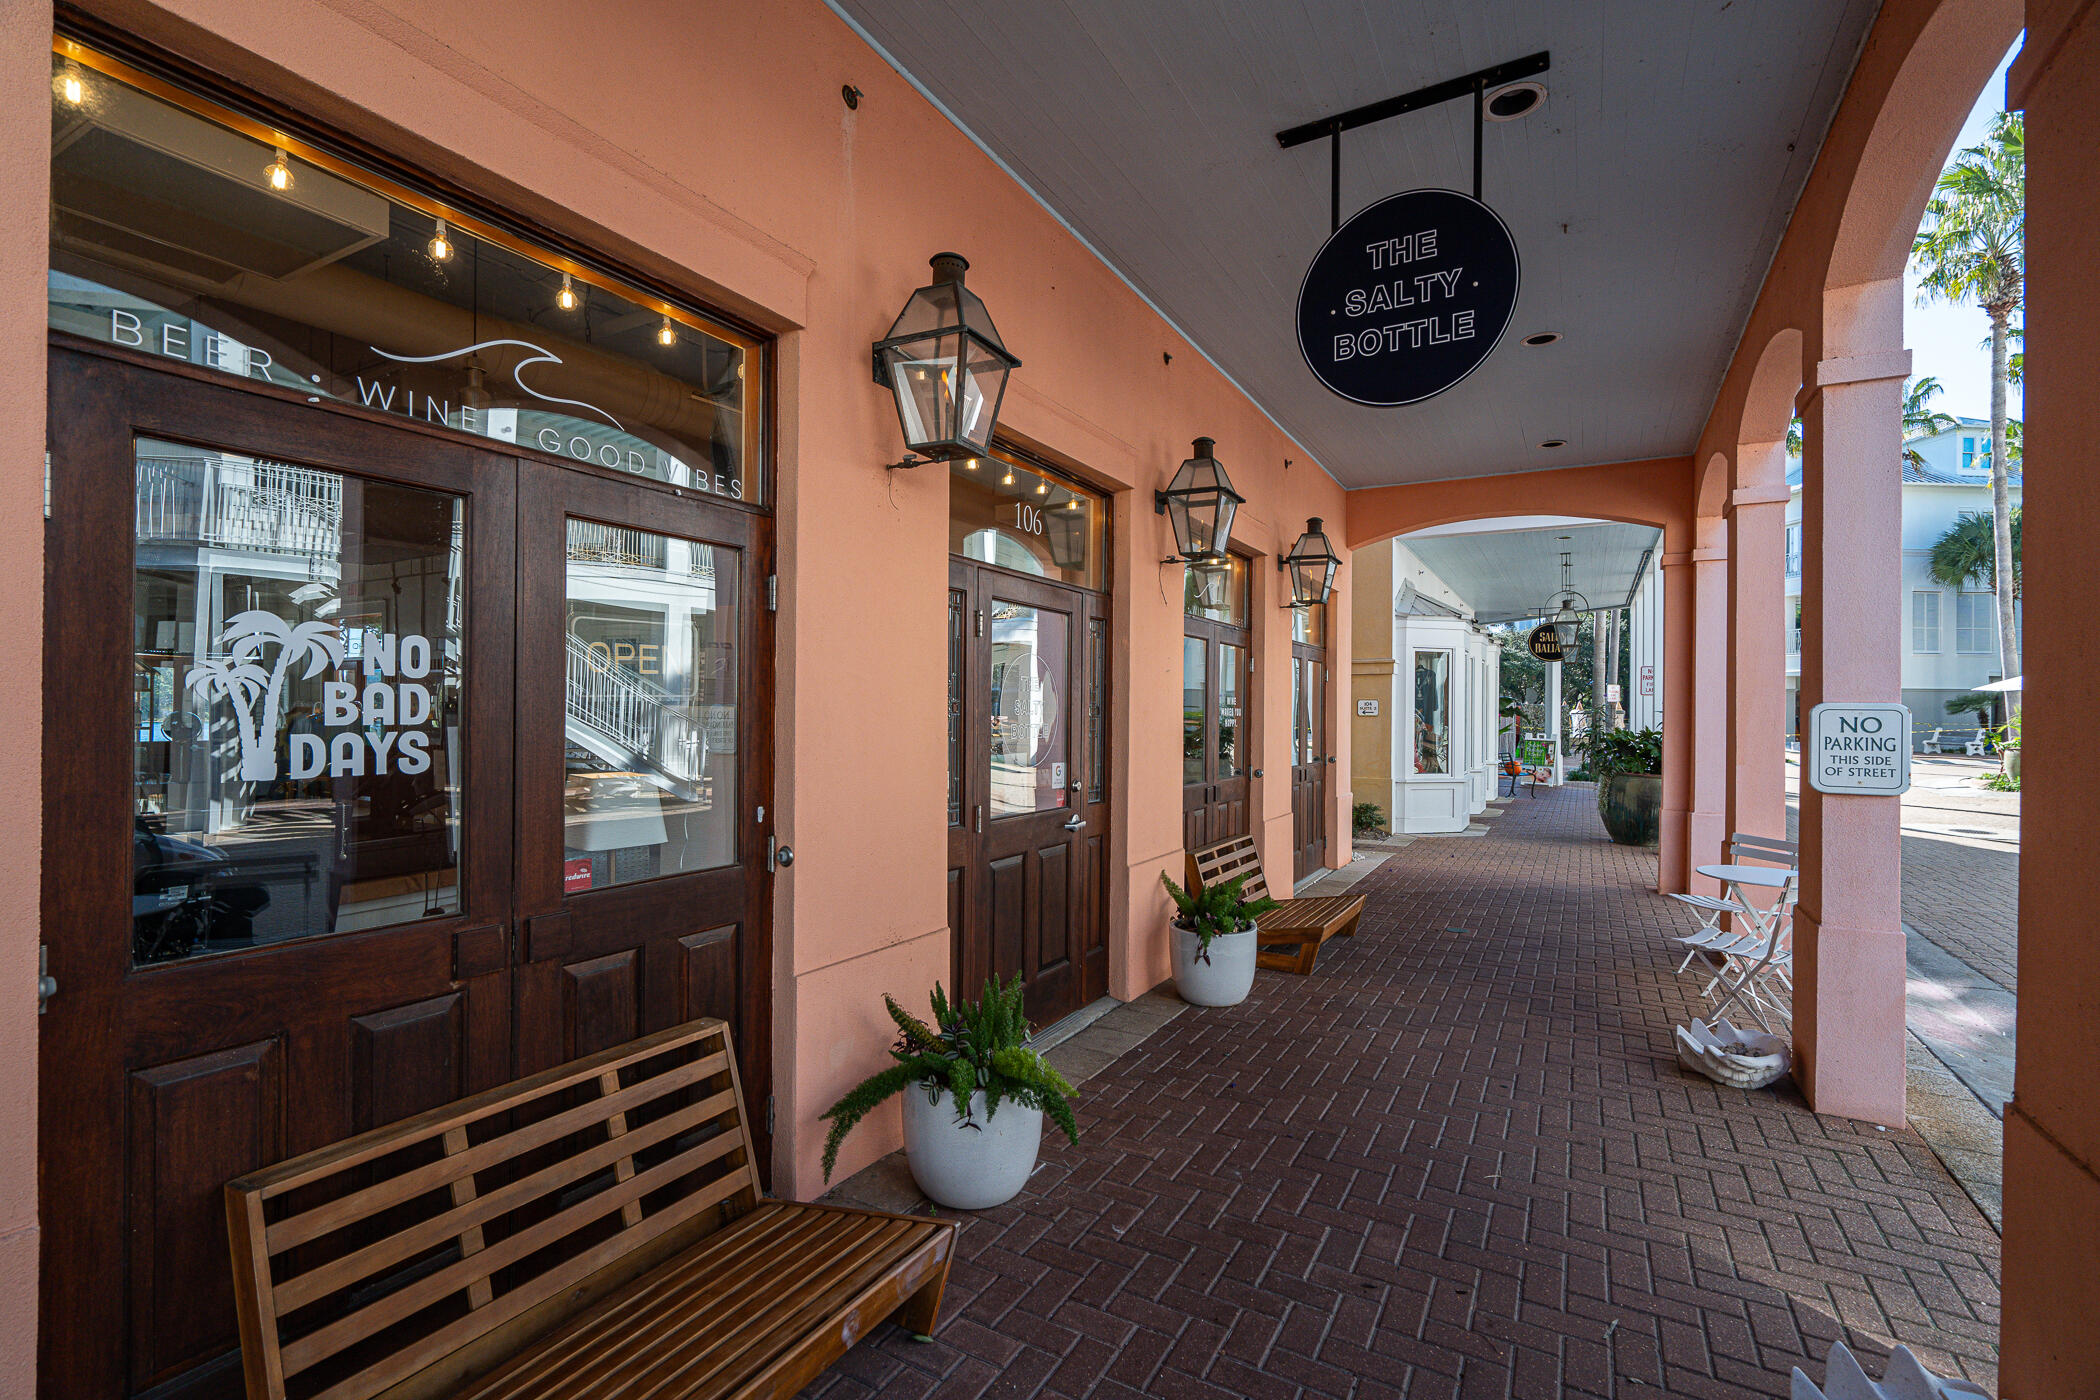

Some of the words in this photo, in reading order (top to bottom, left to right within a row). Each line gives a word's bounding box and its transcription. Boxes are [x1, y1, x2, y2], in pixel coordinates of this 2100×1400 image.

[1366, 229, 1437, 270] THE
[1345, 267, 1463, 317] SALTY
[1334, 310, 1475, 362] BOTTLE
[112, 309, 272, 382] BEER
[357, 375, 478, 433] WINE
[537, 428, 645, 474] GOOD
[663, 460, 742, 500] VIBES
[1015, 502, 1042, 535] 106
[363, 633, 431, 679] NO
[324, 681, 431, 726] BAD
[1839, 716, 1882, 733] NO
[290, 730, 431, 779] DAYS
[1824, 736, 1896, 752] PARKING
[1830, 755, 1859, 765] THIS
[1864, 757, 1892, 766] SIDE
[1825, 766, 1843, 776] OF
[1848, 767, 1896, 778] STREET
